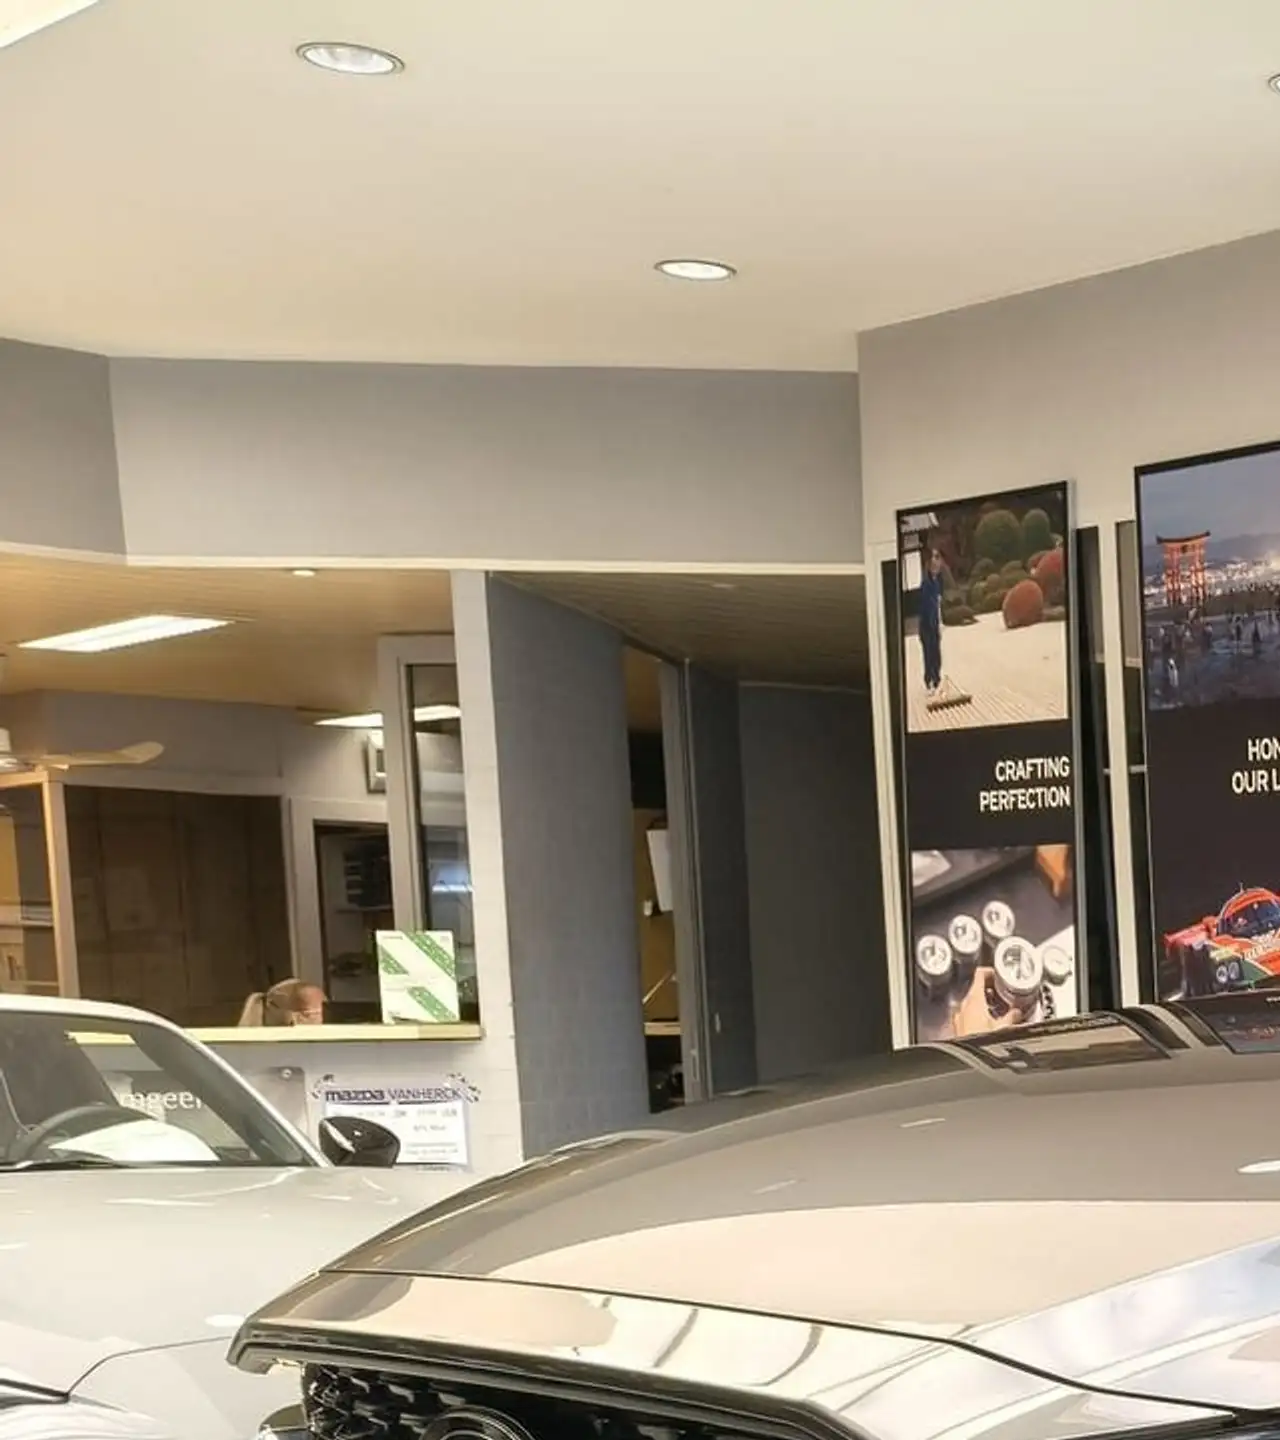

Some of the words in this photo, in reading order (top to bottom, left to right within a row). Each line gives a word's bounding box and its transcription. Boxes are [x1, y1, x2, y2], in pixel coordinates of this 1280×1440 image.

[995, 755, 1070, 782] CRAFTING
[1231, 769, 1269, 794] OUR
[979, 785, 1071, 813] PERFECTION
